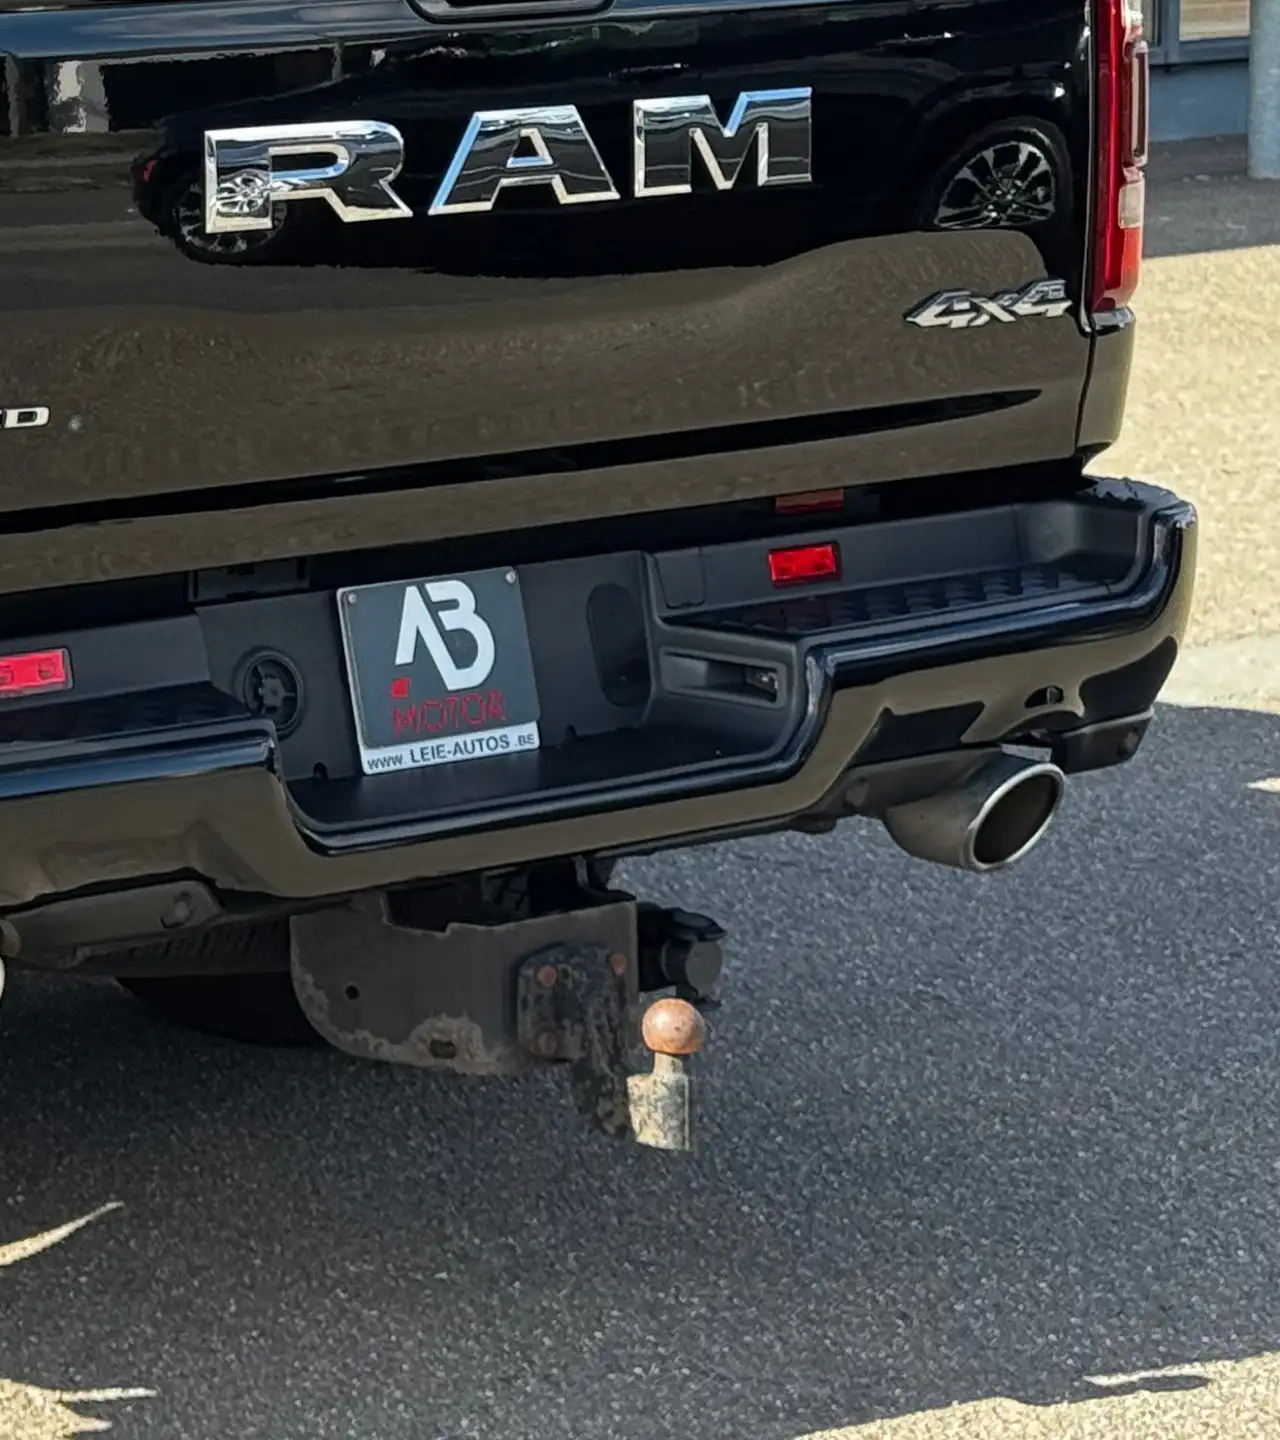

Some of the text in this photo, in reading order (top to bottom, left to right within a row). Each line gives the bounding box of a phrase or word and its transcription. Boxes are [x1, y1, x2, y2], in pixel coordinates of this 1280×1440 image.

[205, 86, 813, 234] RAM
[394, 579, 496, 692] AB
[392, 687, 507, 738] MOTOR
